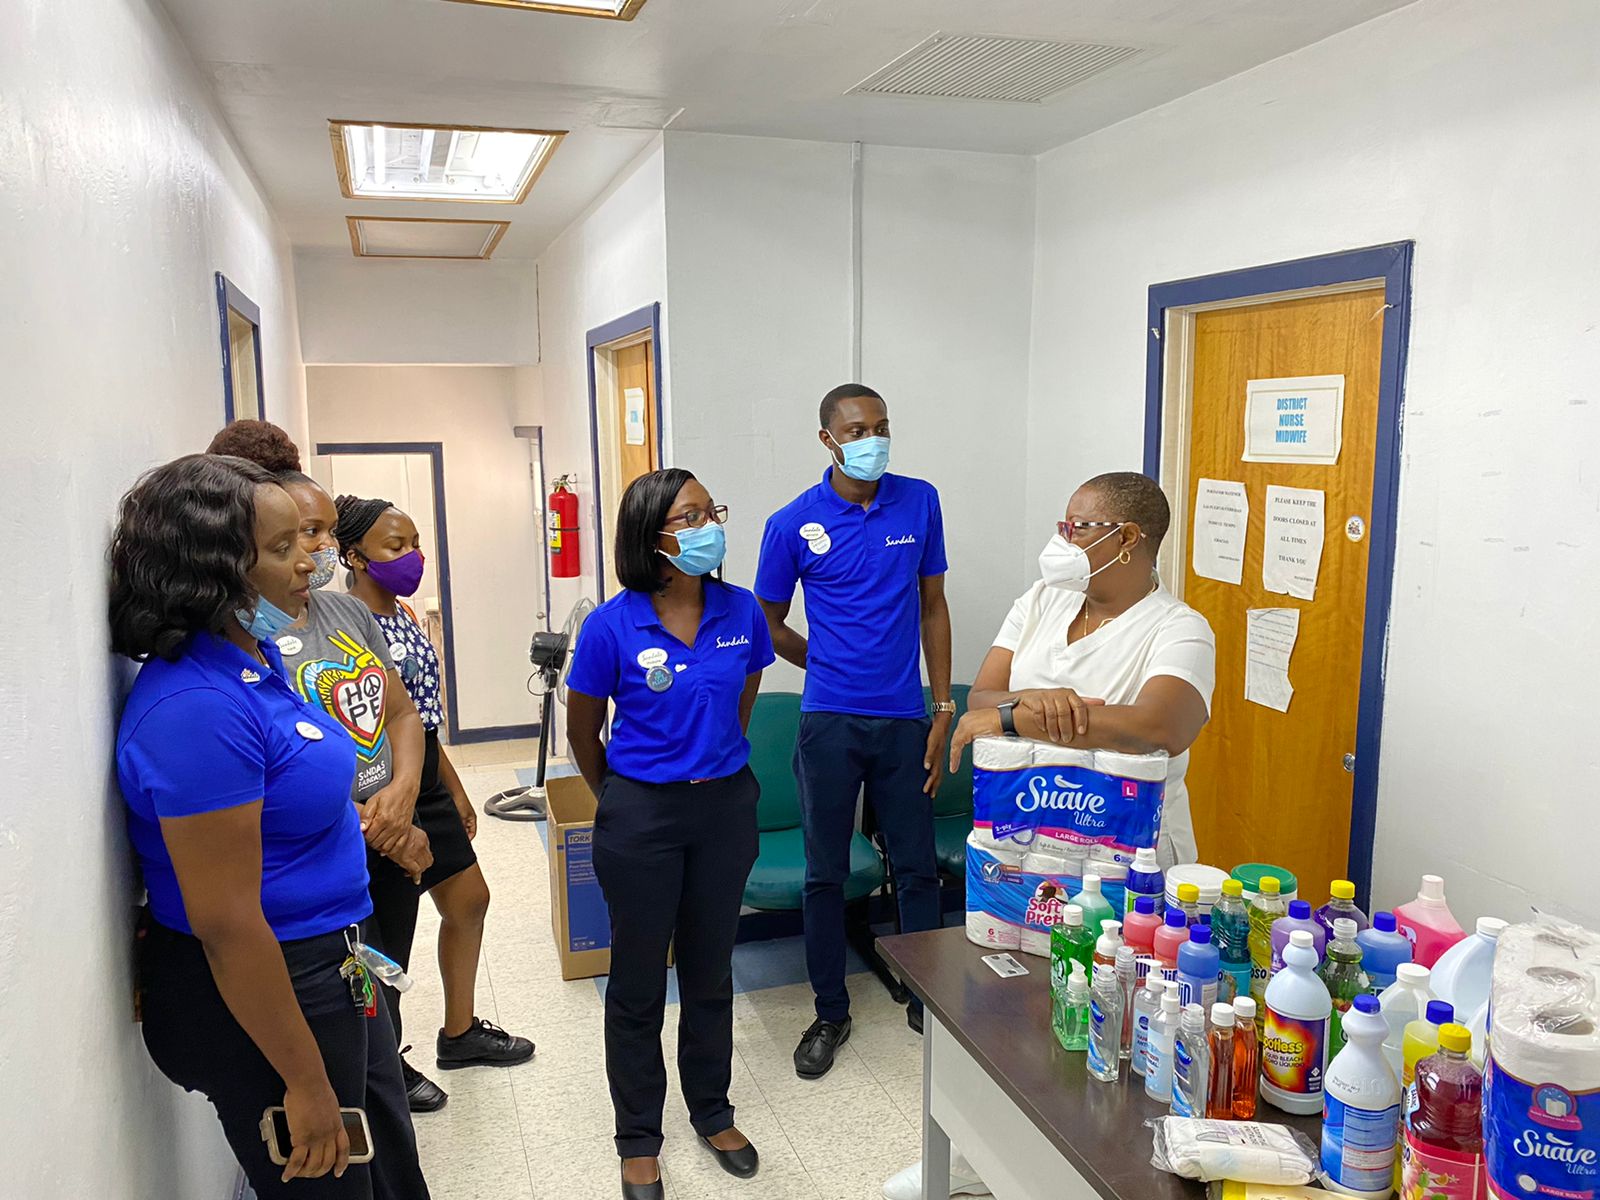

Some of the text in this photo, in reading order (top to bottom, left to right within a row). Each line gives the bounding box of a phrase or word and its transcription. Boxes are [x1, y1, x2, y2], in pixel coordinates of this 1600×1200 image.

[1276, 397, 1308, 410] DISTRICT
[1279, 413, 1304, 426] NURSE
[1275, 430, 1307, 443] MIDWIFE
[1274, 497, 1291, 505] PLEASE
[1289, 518, 1309, 526] CLOSED
[885, 534, 916, 547] Sandals
[1280, 535, 1307, 545] ALL TIMES
[1278, 554, 1307, 566] THANK YOU
[715, 634, 750, 648] Sandals
[1015, 775, 1106, 814] Suave
[1126, 786, 1134, 796] L
[1073, 811, 1106, 828] Ultra
[569, 835, 591, 843] TORK
[1055, 831, 1099, 845] LARGE ROLL
[1113, 854, 1122, 862] 6
[1028, 898, 1062, 914] Soft
[1026, 910, 1064, 926] Prett
[1263, 1036, 1303, 1054] potless
[1513, 1129, 1597, 1165] Suave
[1566, 1163, 1597, 1175] Ultra
[1541, 1186, 1584, 1200] LARGE ROLL
